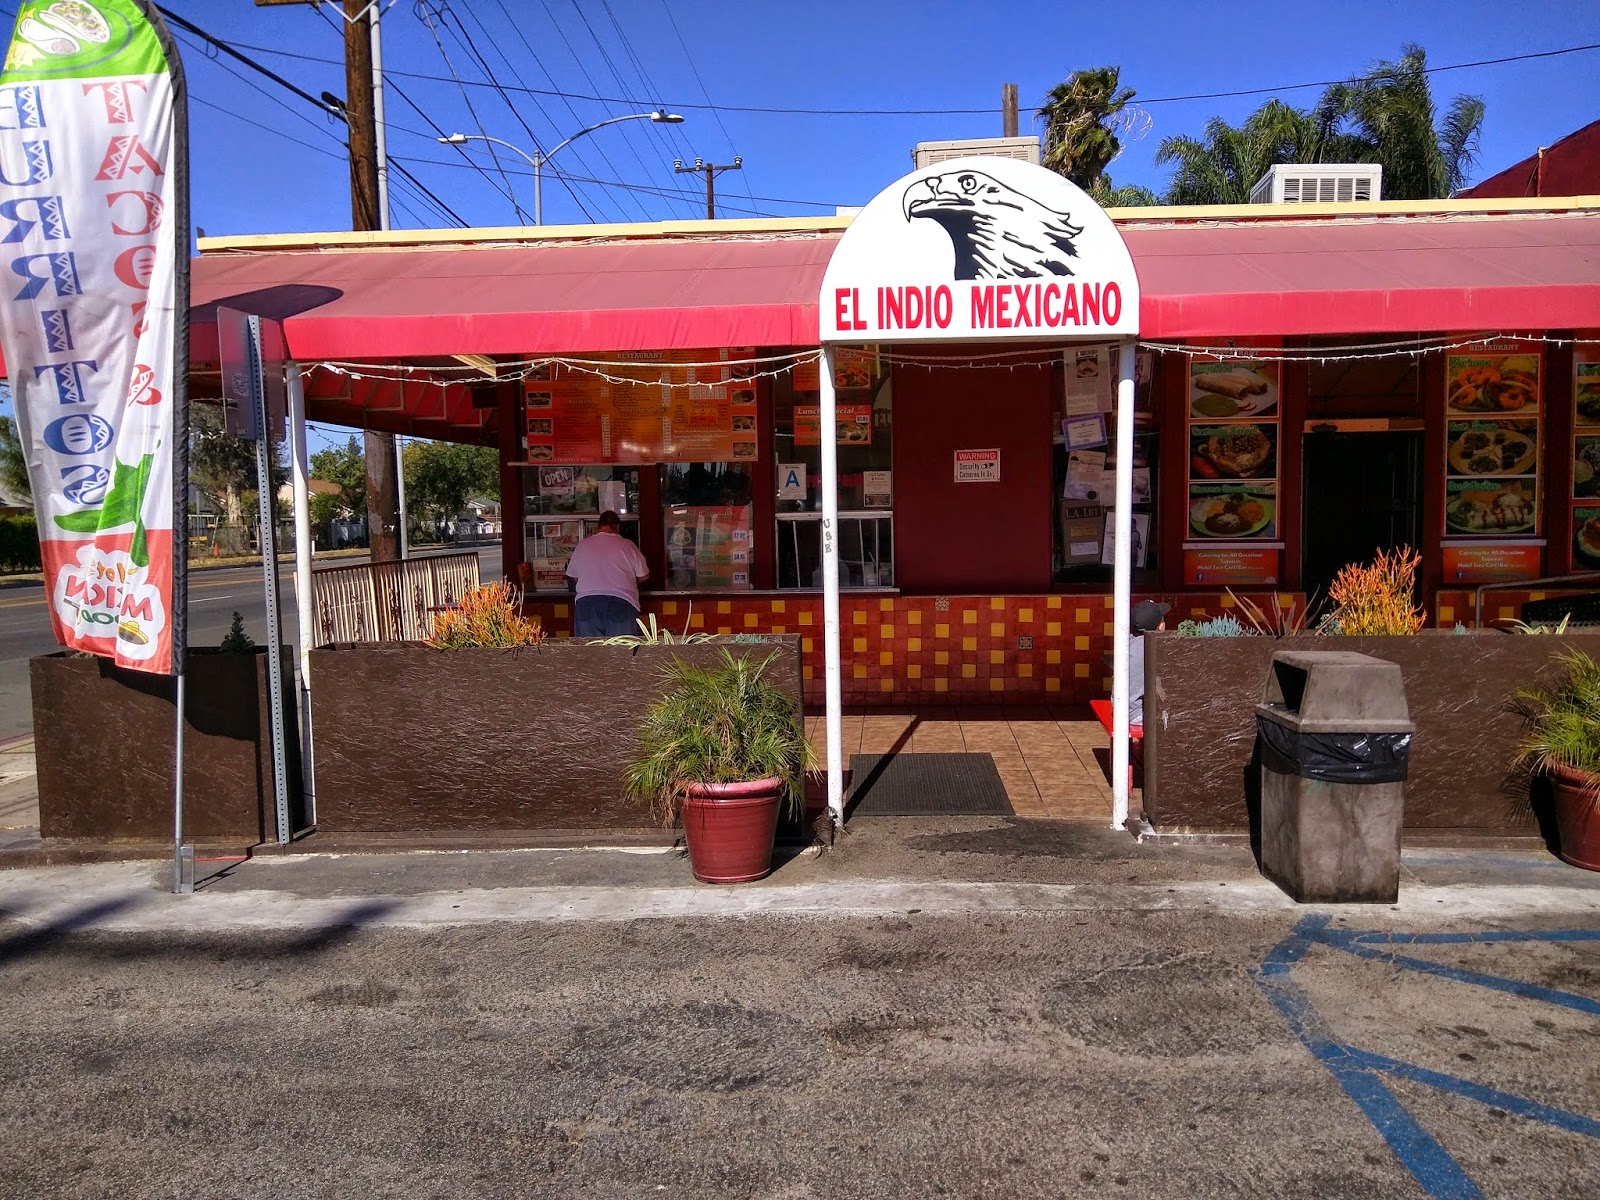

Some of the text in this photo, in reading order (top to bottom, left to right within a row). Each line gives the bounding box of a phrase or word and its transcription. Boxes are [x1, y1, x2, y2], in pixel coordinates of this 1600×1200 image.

[836, 281, 1122, 331] EL INDIO MEXICANO
[958, 451, 997, 461] WARNING
[959, 462, 980, 471] Security
[544, 469, 569, 487] OPEN
[785, 469, 801, 488] A
